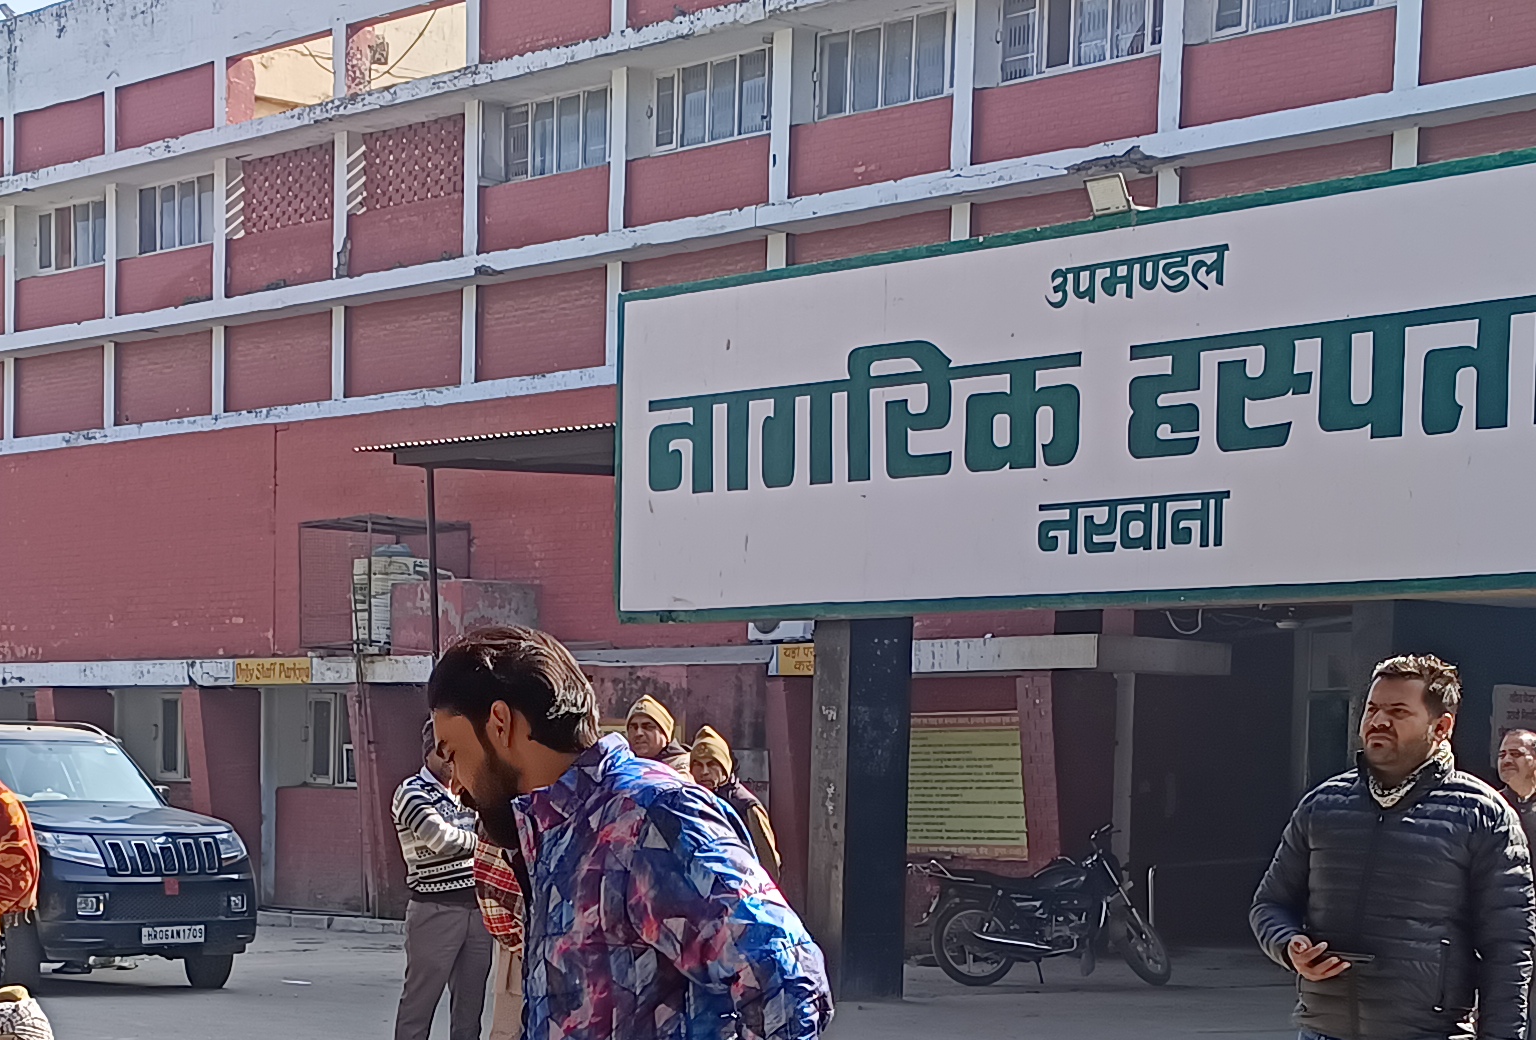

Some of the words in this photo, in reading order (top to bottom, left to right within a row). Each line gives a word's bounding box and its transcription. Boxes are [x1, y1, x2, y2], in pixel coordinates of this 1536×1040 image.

[1045, 243, 1230, 309] उपमण्डल
[648, 339, 1083, 495] नागरिक
[1037, 489, 1231, 555] नरवाना
[256, 662, 276, 680] Staff
